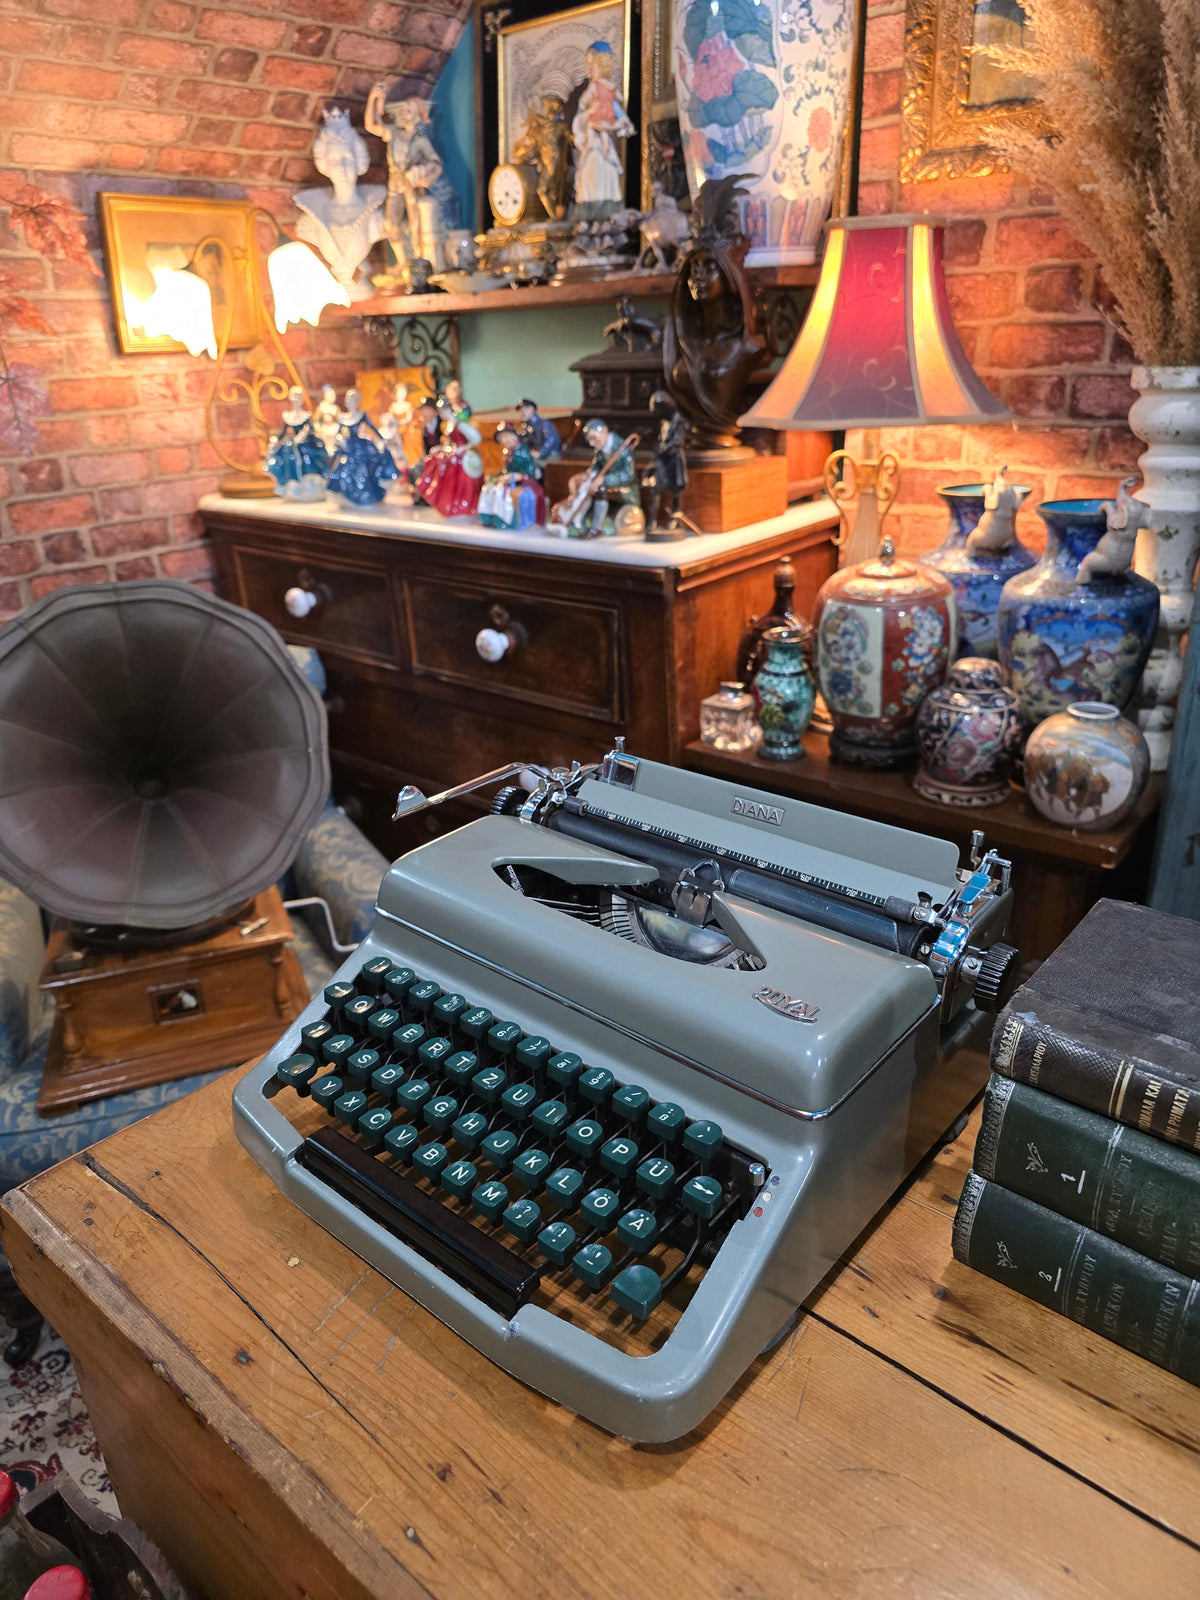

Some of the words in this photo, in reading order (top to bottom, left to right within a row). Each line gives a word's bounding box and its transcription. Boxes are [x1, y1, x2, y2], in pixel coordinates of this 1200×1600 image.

[733, 799, 779, 824] DIANA
[557, 1060, 567, 1068] 8
[589, 1077, 599, 1085] 9
[377, 1012, 394, 1024] W
[402, 1028, 418, 1039] E
[428, 1042, 443, 1056] R
[457, 1056, 471, 1067] T
[482, 1073, 499, 1084] Z
[512, 1089, 528, 1101] U
[545, 1107, 556, 1118] I
[578, 1126, 594, 1138] O
[612, 1143, 629, 1155] P
[648, 1161, 669, 1178] Ü
[322, 1080, 337, 1091] Y
[344, 1096, 360, 1108] X
[370, 1113, 385, 1124] C
[397, 1129, 412, 1141] V
[423, 1148, 439, 1160] B
[451, 1166, 469, 1180] N
[481, 1186, 501, 1201] M
[331, 1040, 345, 1049] A
[357, 1054, 372, 1064] S
[380, 1069, 396, 1079] D
[407, 1084, 423, 1094] F
[434, 1101, 449, 1113] G
[462, 1118, 479, 1130] H
[493, 1139, 510, 1148] J
[524, 1155, 541, 1169] K
[557, 1174, 570, 1189] L
[593, 1193, 611, 1208] Ö
[628, 1213, 650, 1231] Ä
[1060, 1173, 1076, 1182] 1
[1038, 1270, 1052, 1282] 2
